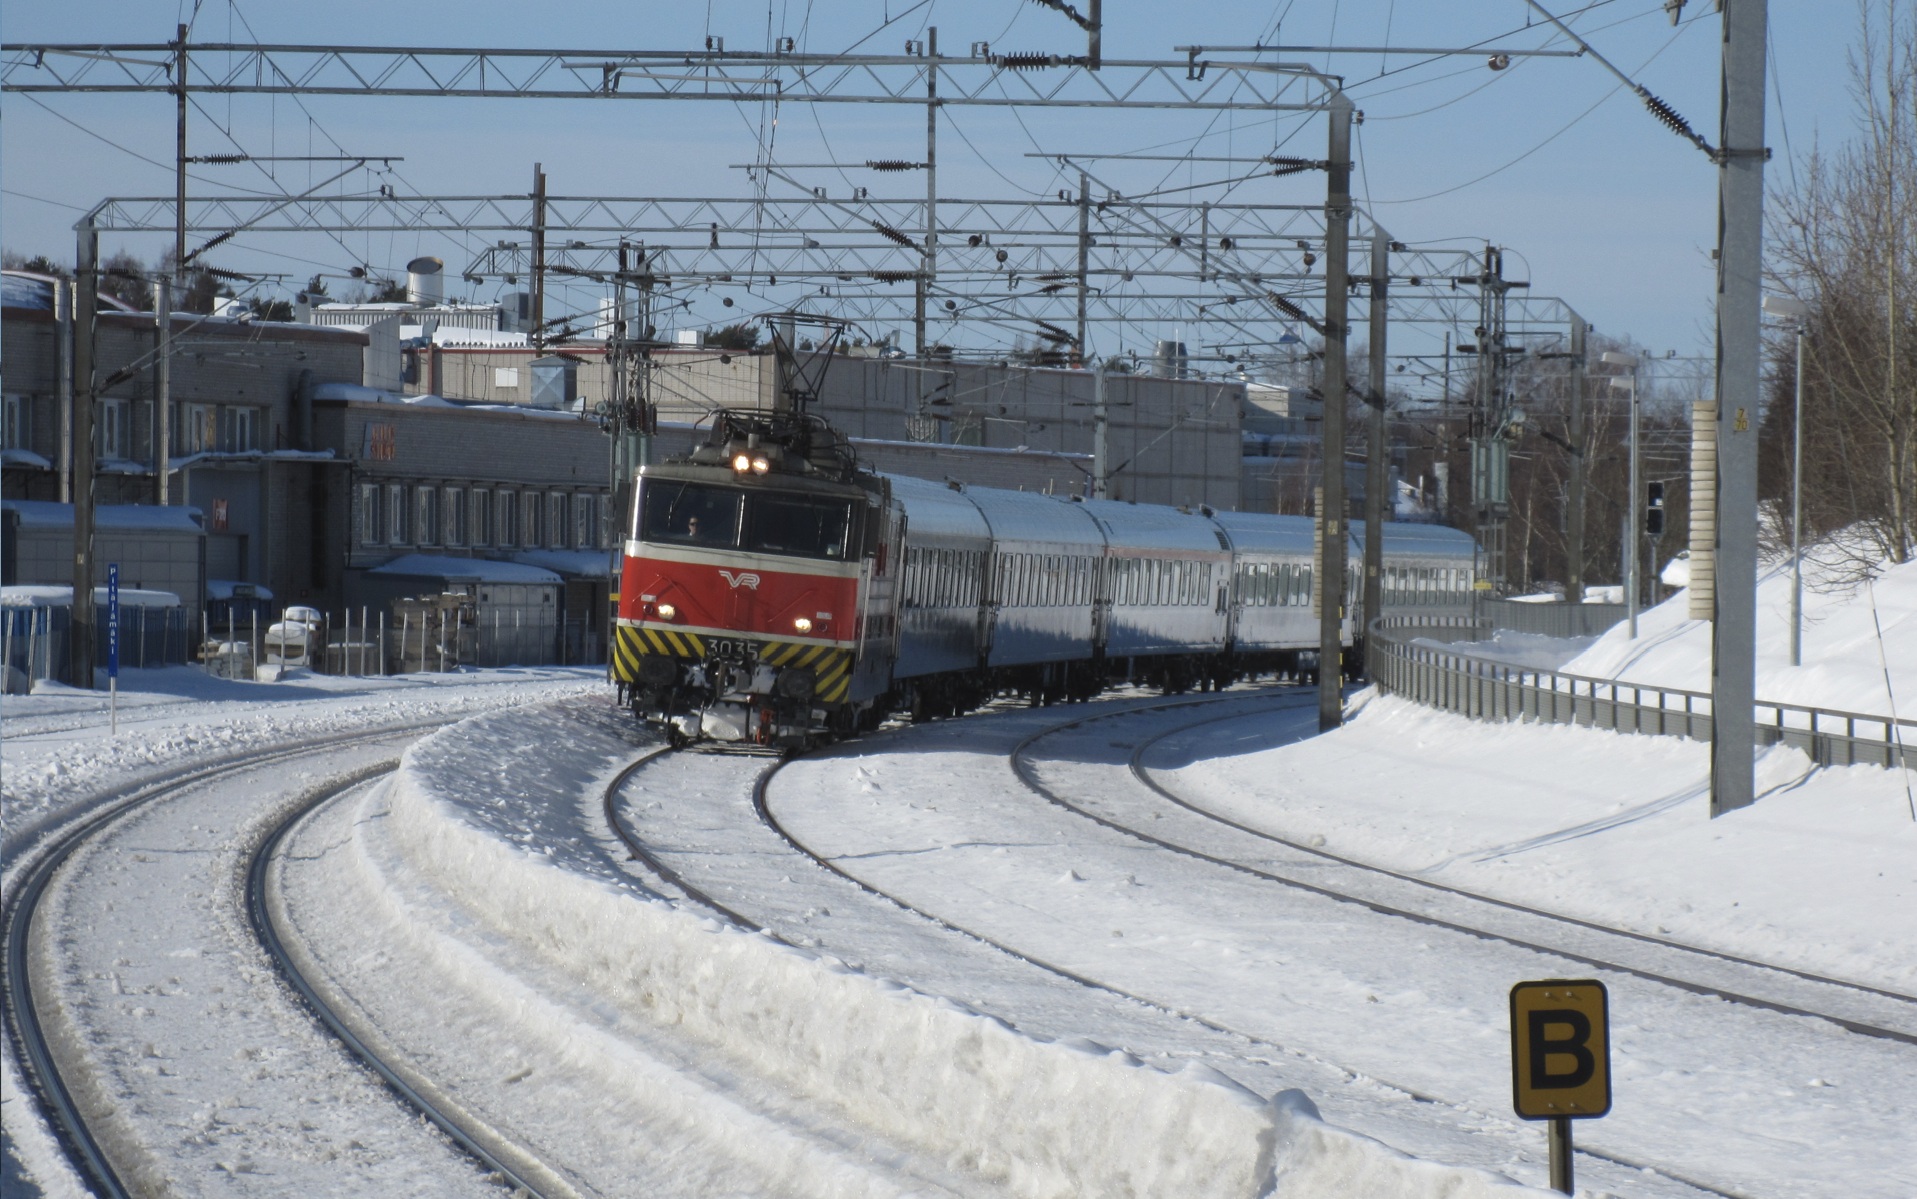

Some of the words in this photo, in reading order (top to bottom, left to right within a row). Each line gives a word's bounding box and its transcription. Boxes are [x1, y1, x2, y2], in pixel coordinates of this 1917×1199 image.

[718, 570, 761, 590] VR
[708, 639, 759, 661] 3035
[1528, 1008, 1595, 1090] B
